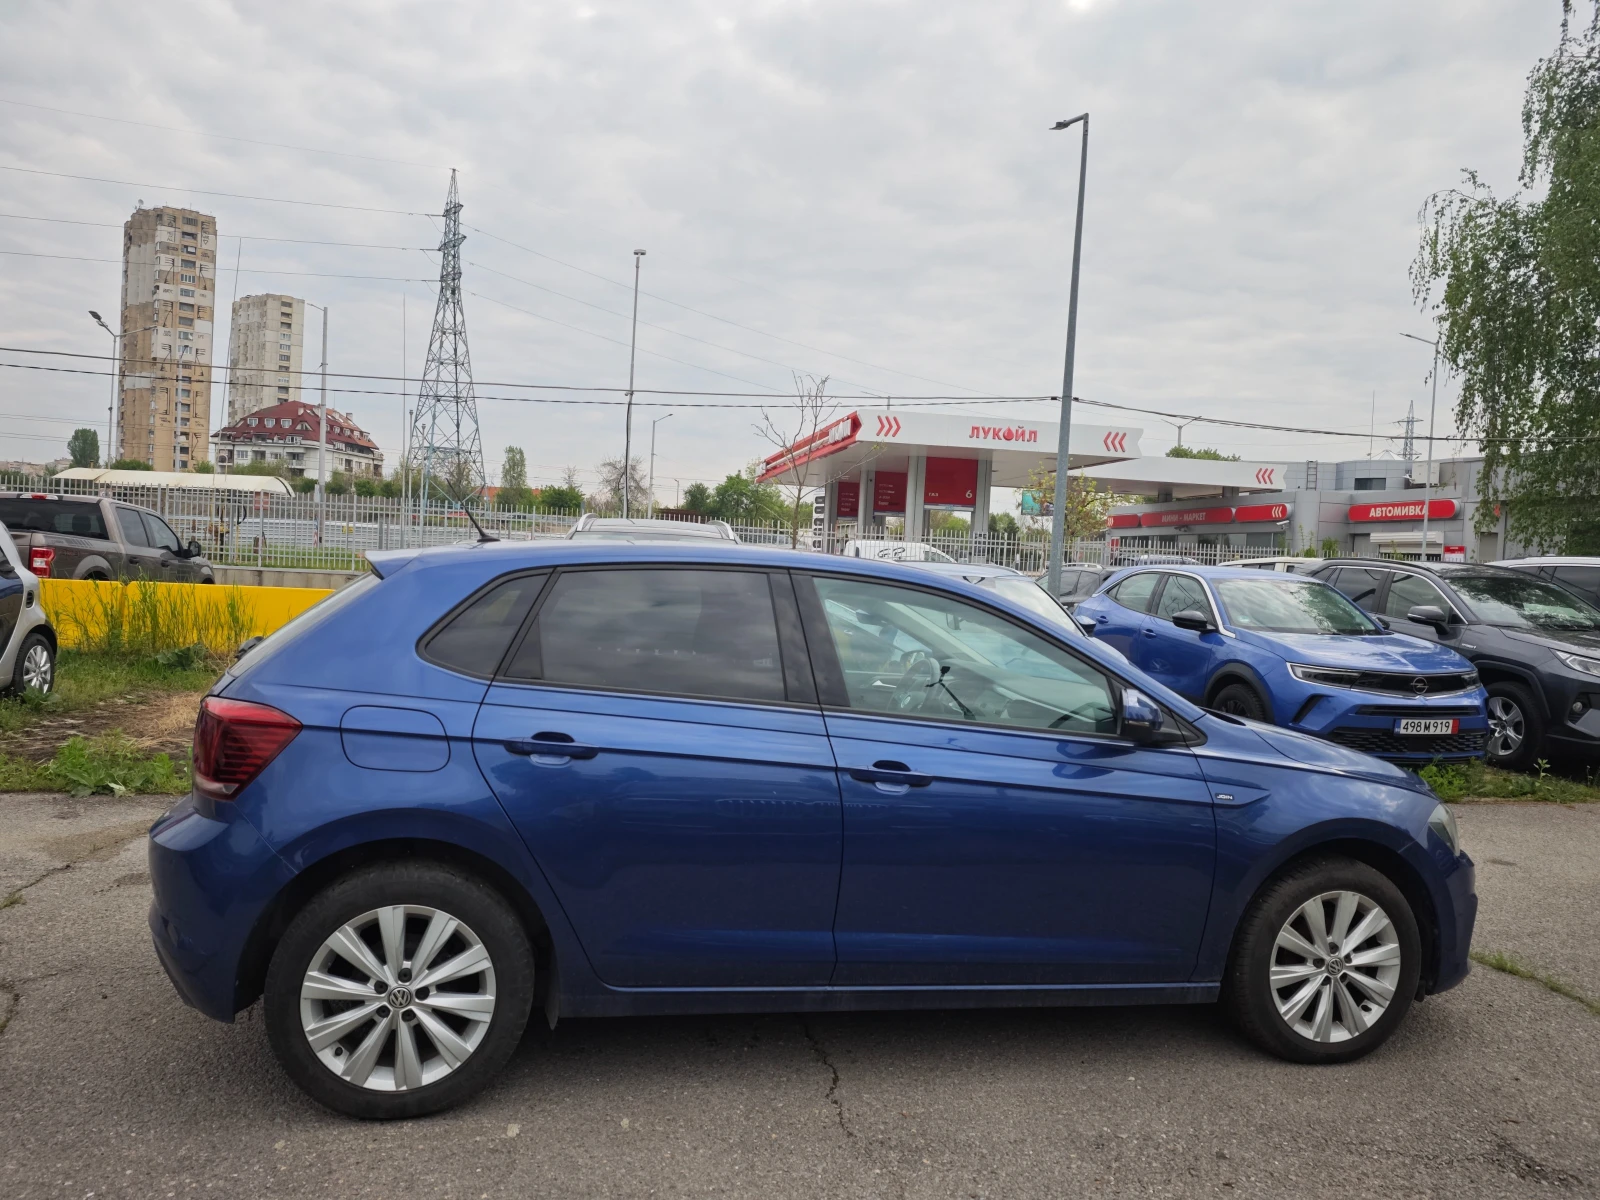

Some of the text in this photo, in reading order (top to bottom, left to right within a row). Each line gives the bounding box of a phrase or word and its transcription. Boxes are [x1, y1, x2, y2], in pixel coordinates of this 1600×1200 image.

[965, 489, 973, 499] 6
[1369, 504, 1429, 518] АВТОМИВКА
[1161, 514, 1179, 522] МИНИ
[1183, 512, 1206, 521] МАРКЕТ
